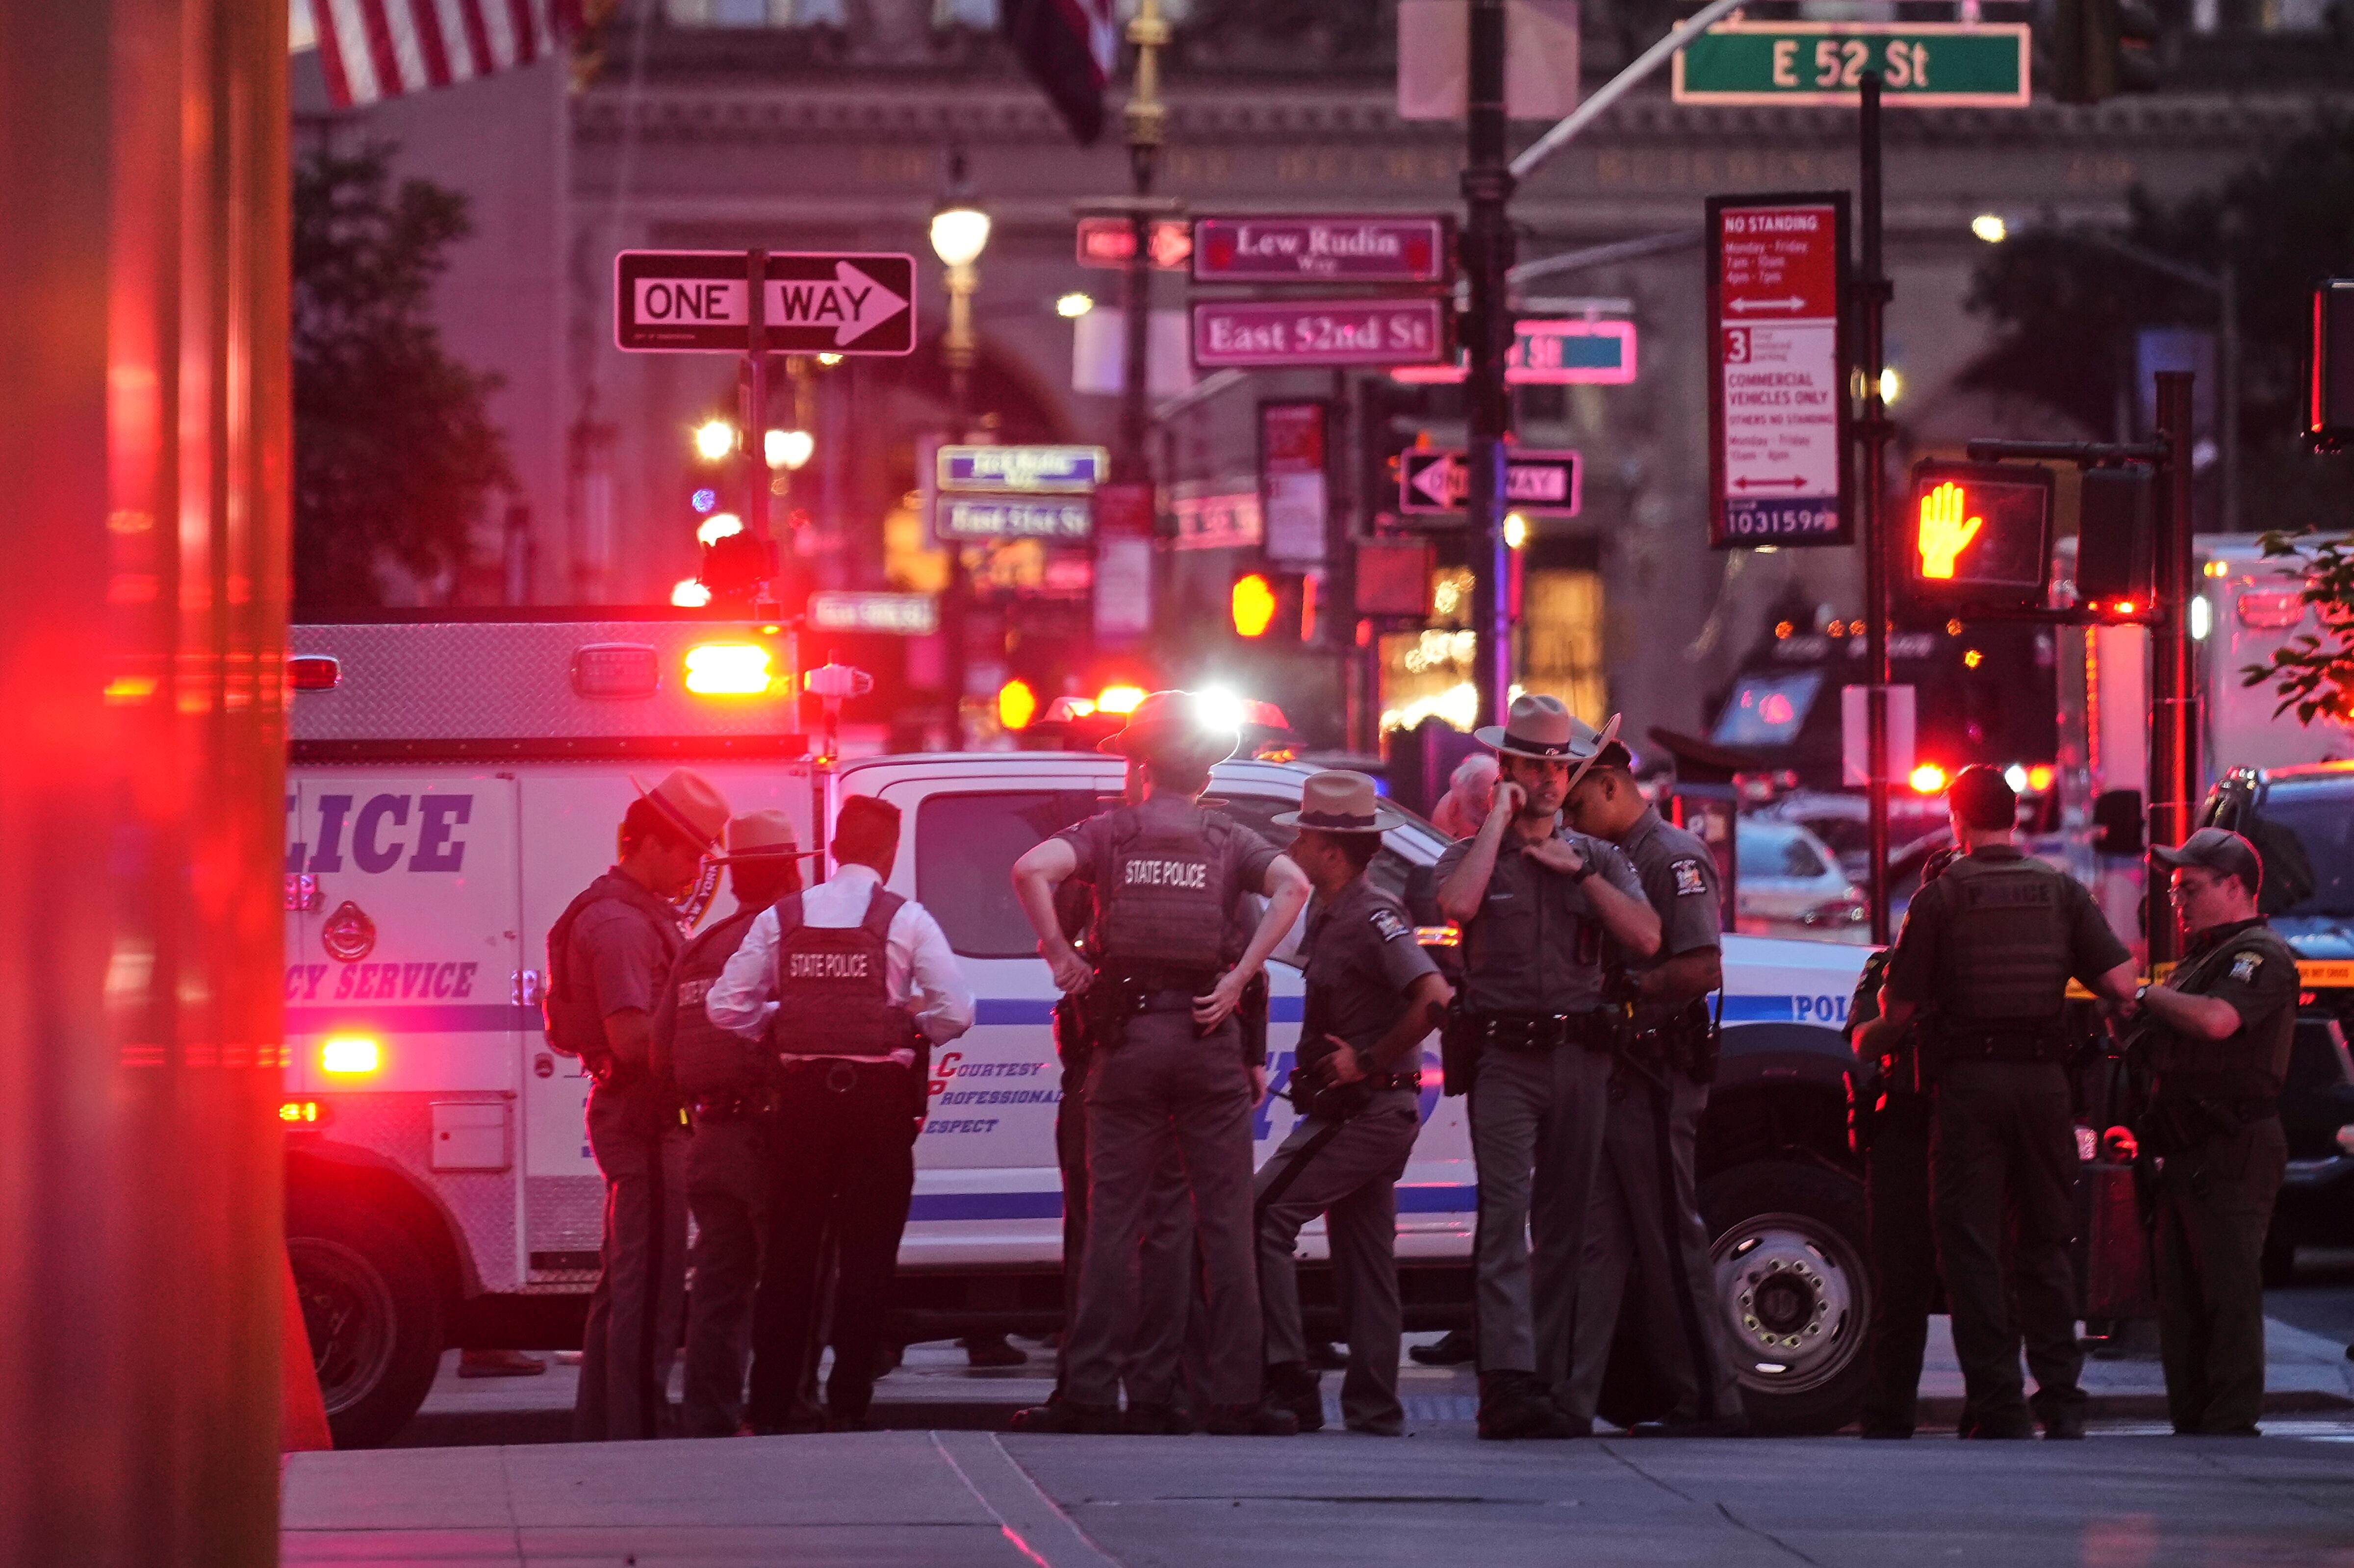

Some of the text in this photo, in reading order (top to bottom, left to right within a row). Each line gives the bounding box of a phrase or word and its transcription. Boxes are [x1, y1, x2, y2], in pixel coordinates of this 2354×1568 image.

[1773, 40, 1928, 87] E 52 St
[1725, 215, 1817, 233] NO STANDING
[1237, 226, 1399, 256] Lew Rudin
[1297, 258, 1337, 277] Way
[645, 283, 871, 321] ONE WAY
[1209, 316, 1427, 352] East 52nd St
[1728, 329, 1746, 362] 3
[1729, 373, 1813, 386] COMMERCIAL
[1729, 391, 1828, 405] VEHICLES ONLY
[1729, 511, 1812, 534] 103159
[1126, 859, 1207, 888] STATE POLICE
[790, 954, 868, 977] STATE POLICE
[285, 961, 479, 999] CY SERVICE
[936, 1052, 1044, 1077] COURTESY
[913, 1116, 999, 1134] ESPECT
